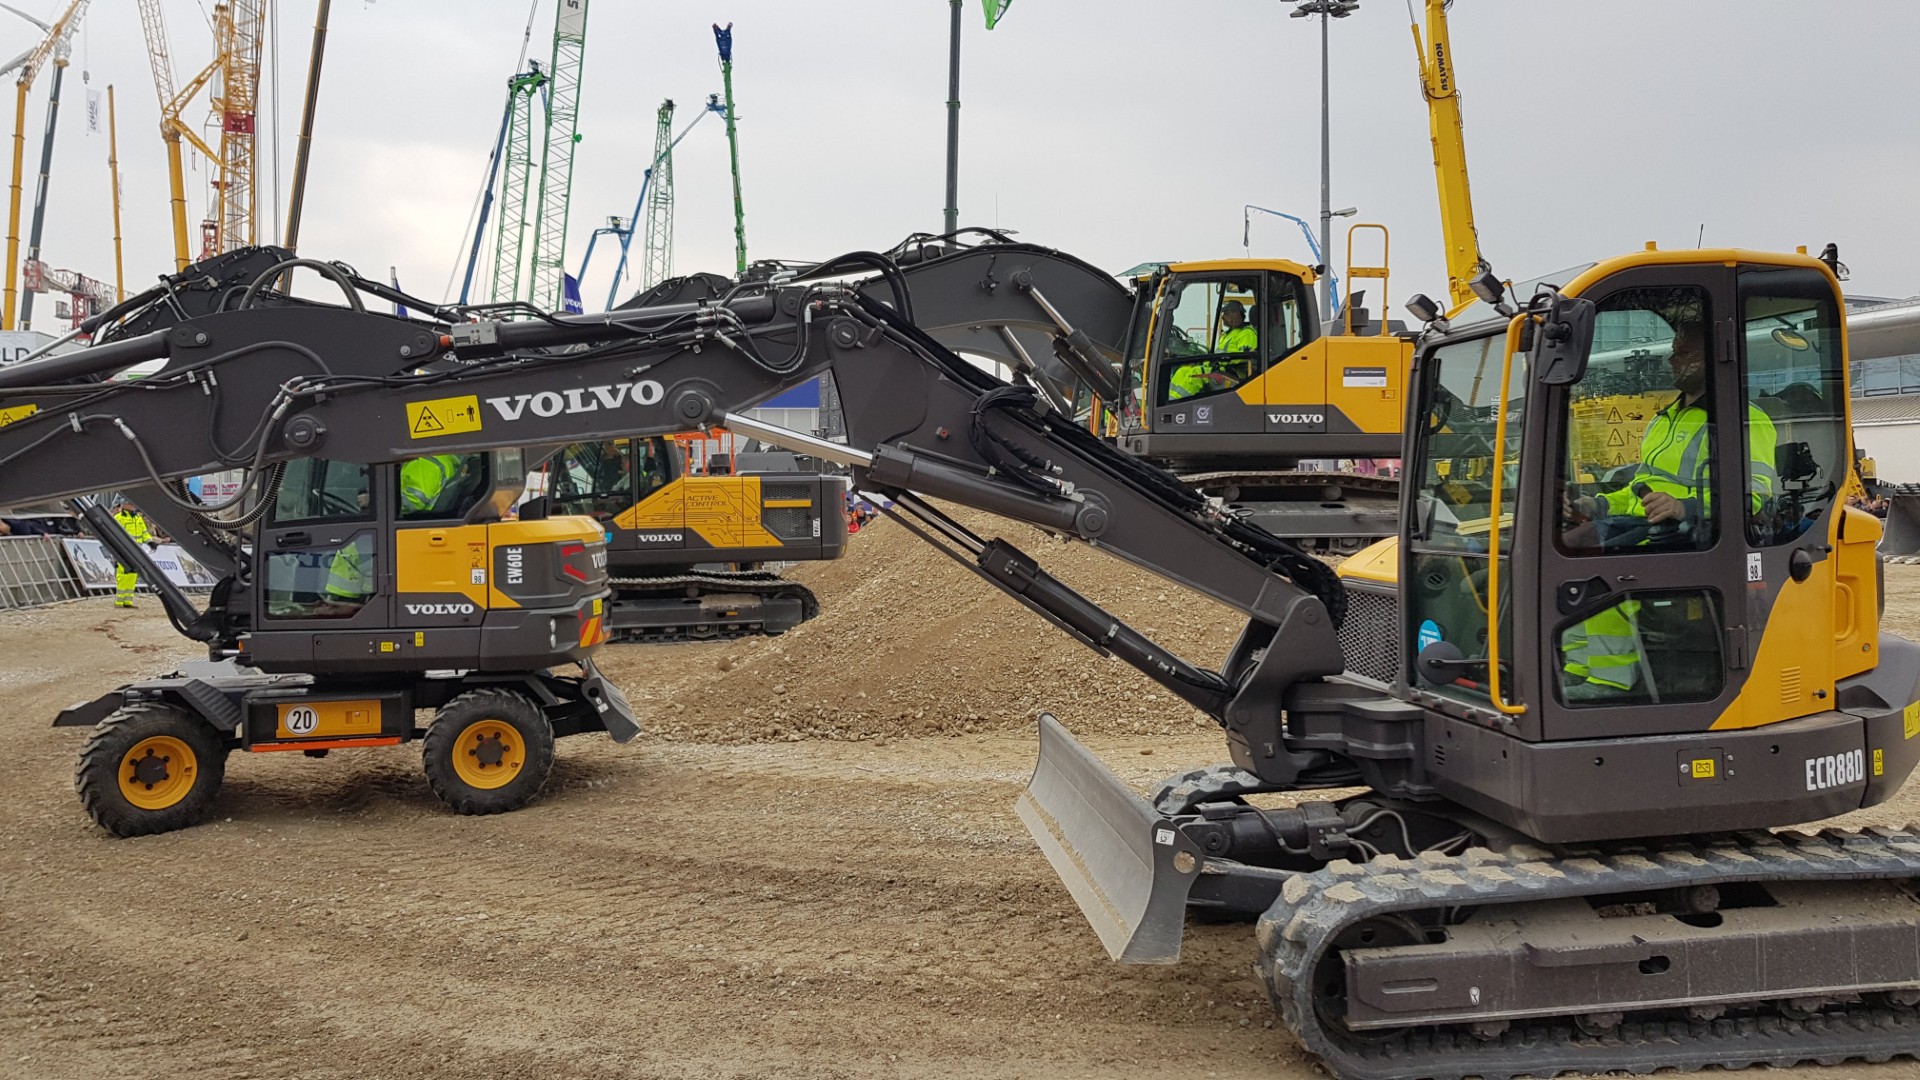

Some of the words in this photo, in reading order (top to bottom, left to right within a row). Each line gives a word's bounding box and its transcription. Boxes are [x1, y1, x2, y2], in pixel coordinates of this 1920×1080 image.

[1435, 43, 1448, 91] KOMATSU
[565, 298, 583, 309] VOVO
[0, 347, 31, 362] LD
[486, 380, 665, 421] VOLVO
[1268, 413, 1323, 424] VOLVO
[685, 500, 729, 508] CONTROL
[686, 494, 720, 502] ACTIVE
[638, 533, 683, 542] VOLVO
[507, 547, 523, 584] EW60E
[1750, 565, 1759, 579] 98
[473, 575, 482, 584] 98
[405, 603, 474, 615] VOLVO
[292, 710, 312, 730] 20
[1805, 749, 1863, 791] ECR88D
